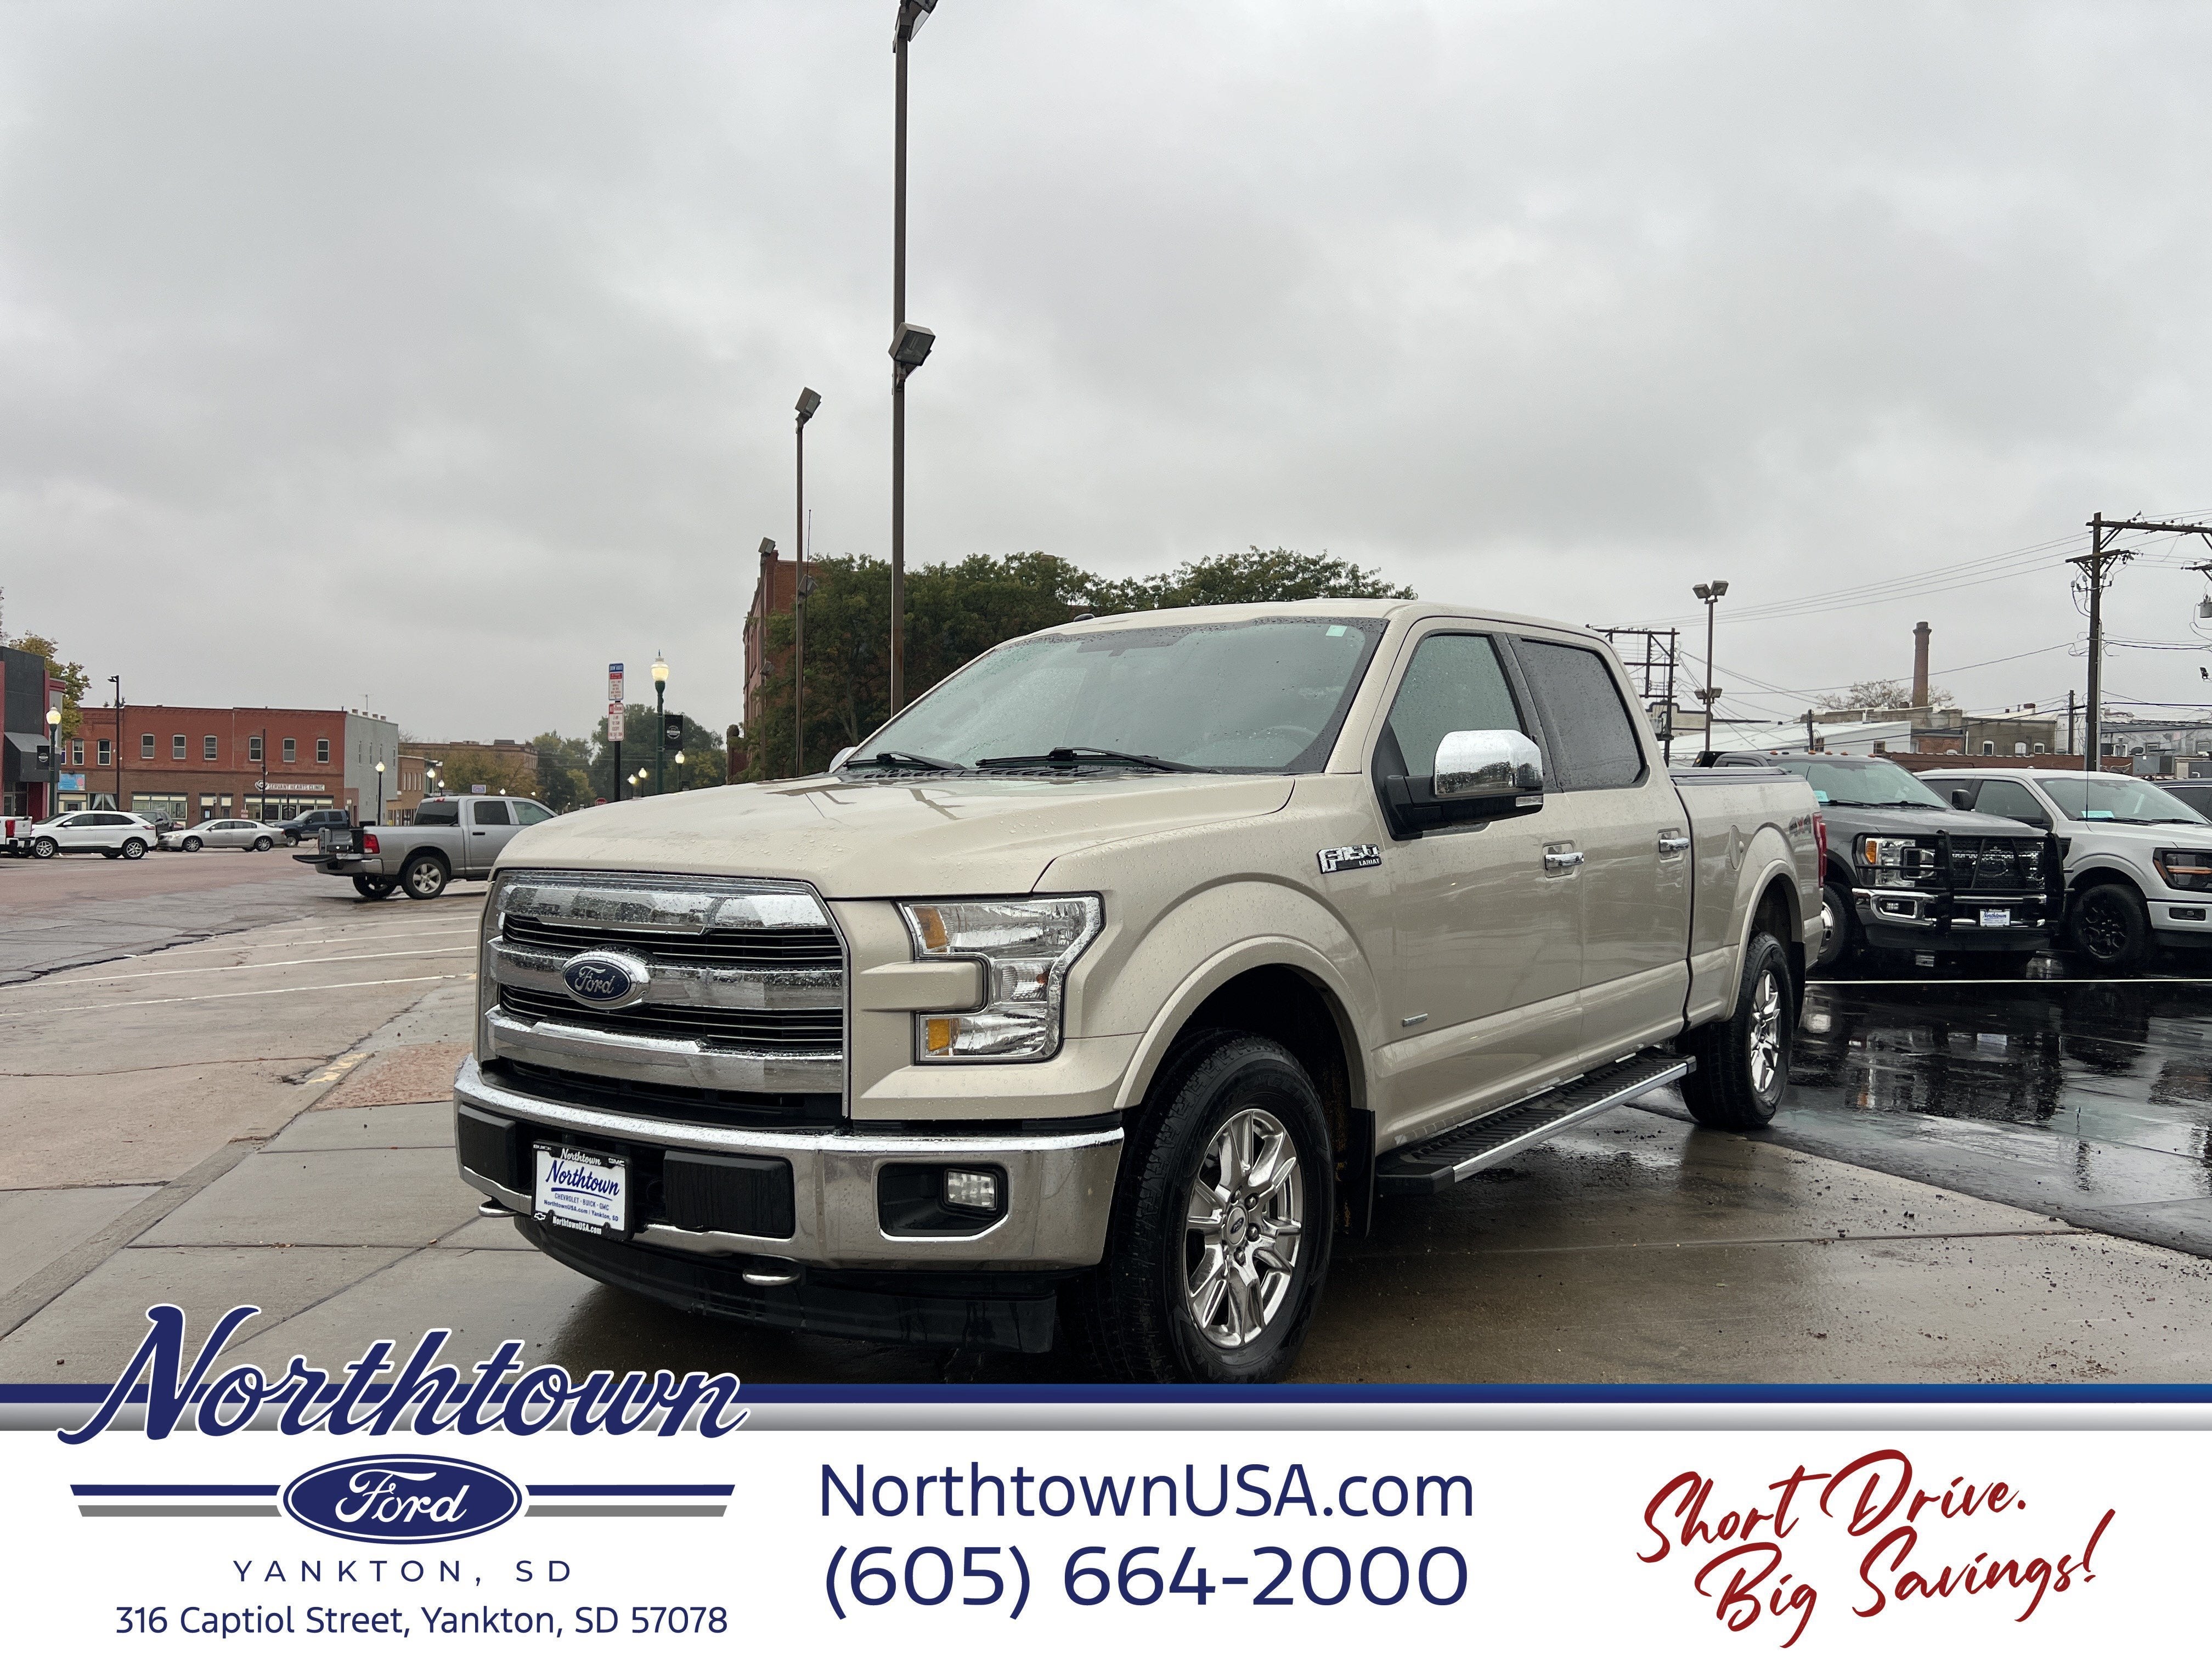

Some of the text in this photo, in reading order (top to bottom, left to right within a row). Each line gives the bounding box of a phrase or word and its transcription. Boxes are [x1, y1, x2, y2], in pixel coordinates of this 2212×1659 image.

[1358, 858, 1380, 866] LARIAT
[574, 966, 616, 994] Ford
[560, 1148, 602, 1166] Northtown
[608, 1158, 625, 1167] GMC
[545, 1159, 620, 1197] Northtown
[544, 1199, 588, 1215] NorthtownUSA.com
[591, 1210, 611, 1221] Yankton,
[554, 1193, 610, 1211] CHEVROLET BUICK GMC
[552, 1216, 602, 1235] NorthtownUSA.com
